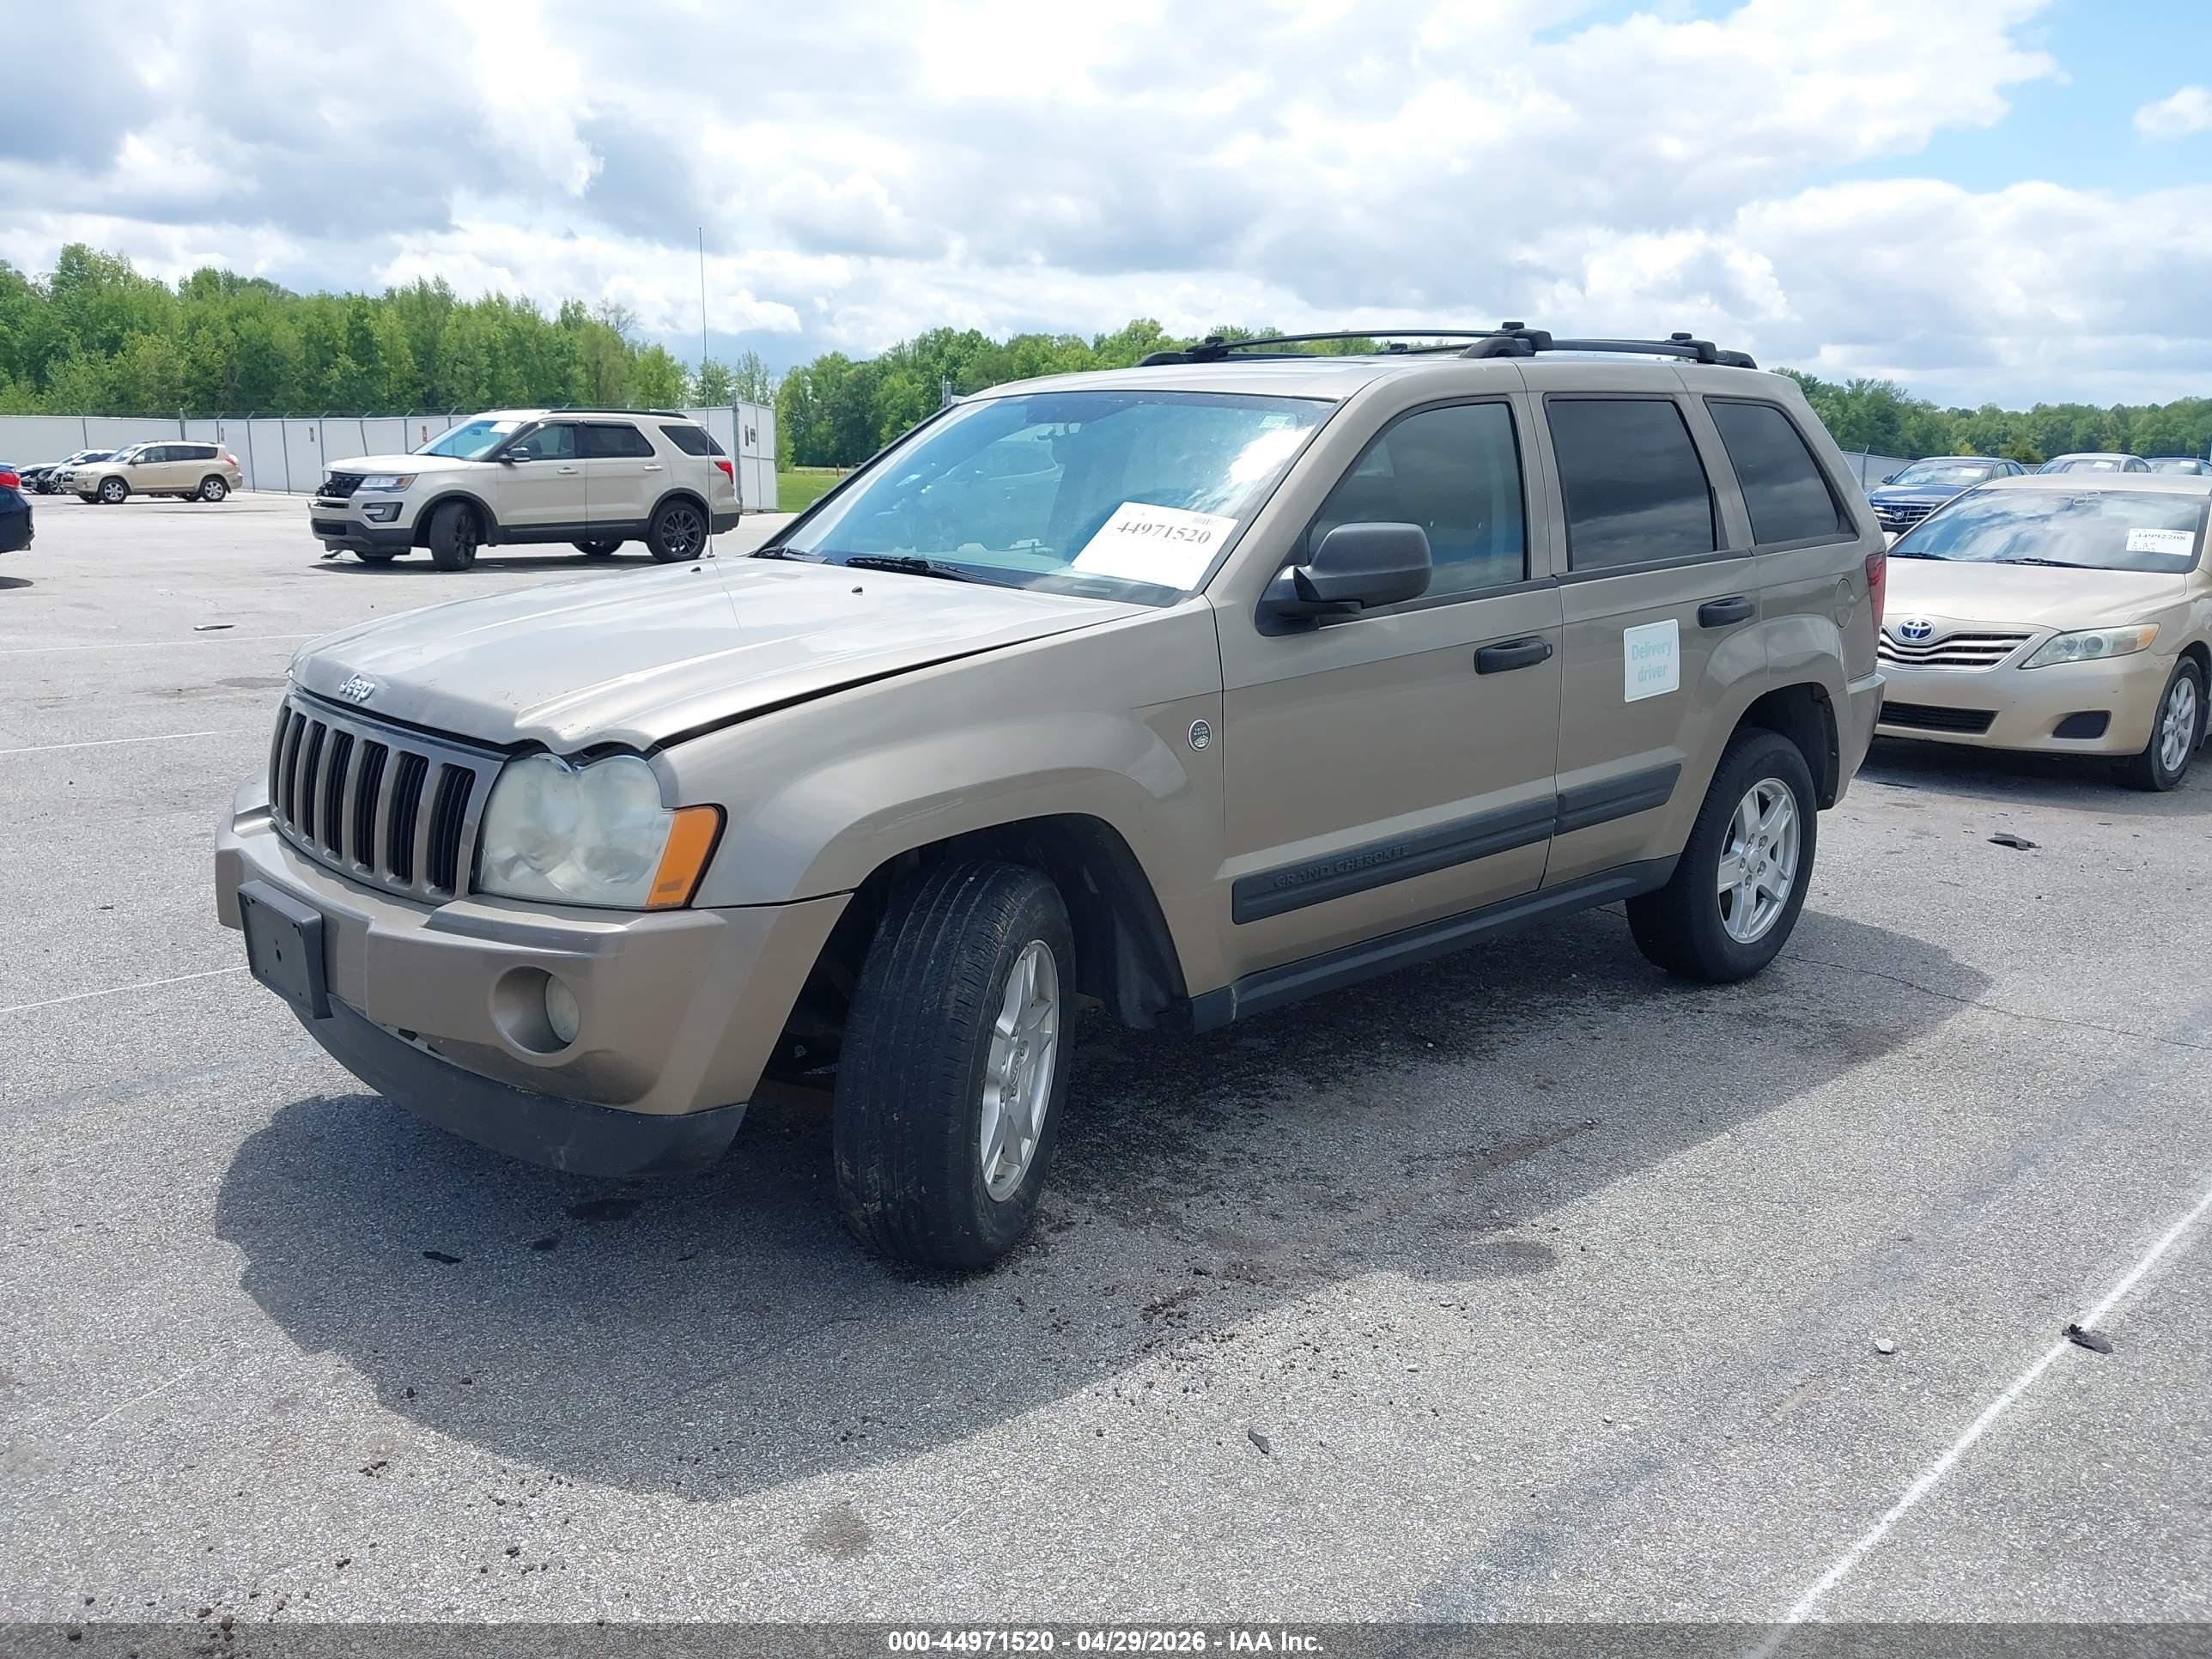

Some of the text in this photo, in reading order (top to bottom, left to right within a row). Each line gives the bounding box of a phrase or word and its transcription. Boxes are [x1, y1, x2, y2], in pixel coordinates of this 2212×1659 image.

[1116, 521, 1212, 544] 44971520
[1632, 641, 1672, 659] Delivery
[1638, 665, 1668, 682] driver
[338, 672, 375, 702] Jeep
[1274, 845, 1409, 888] GRAND CHEROKEE
